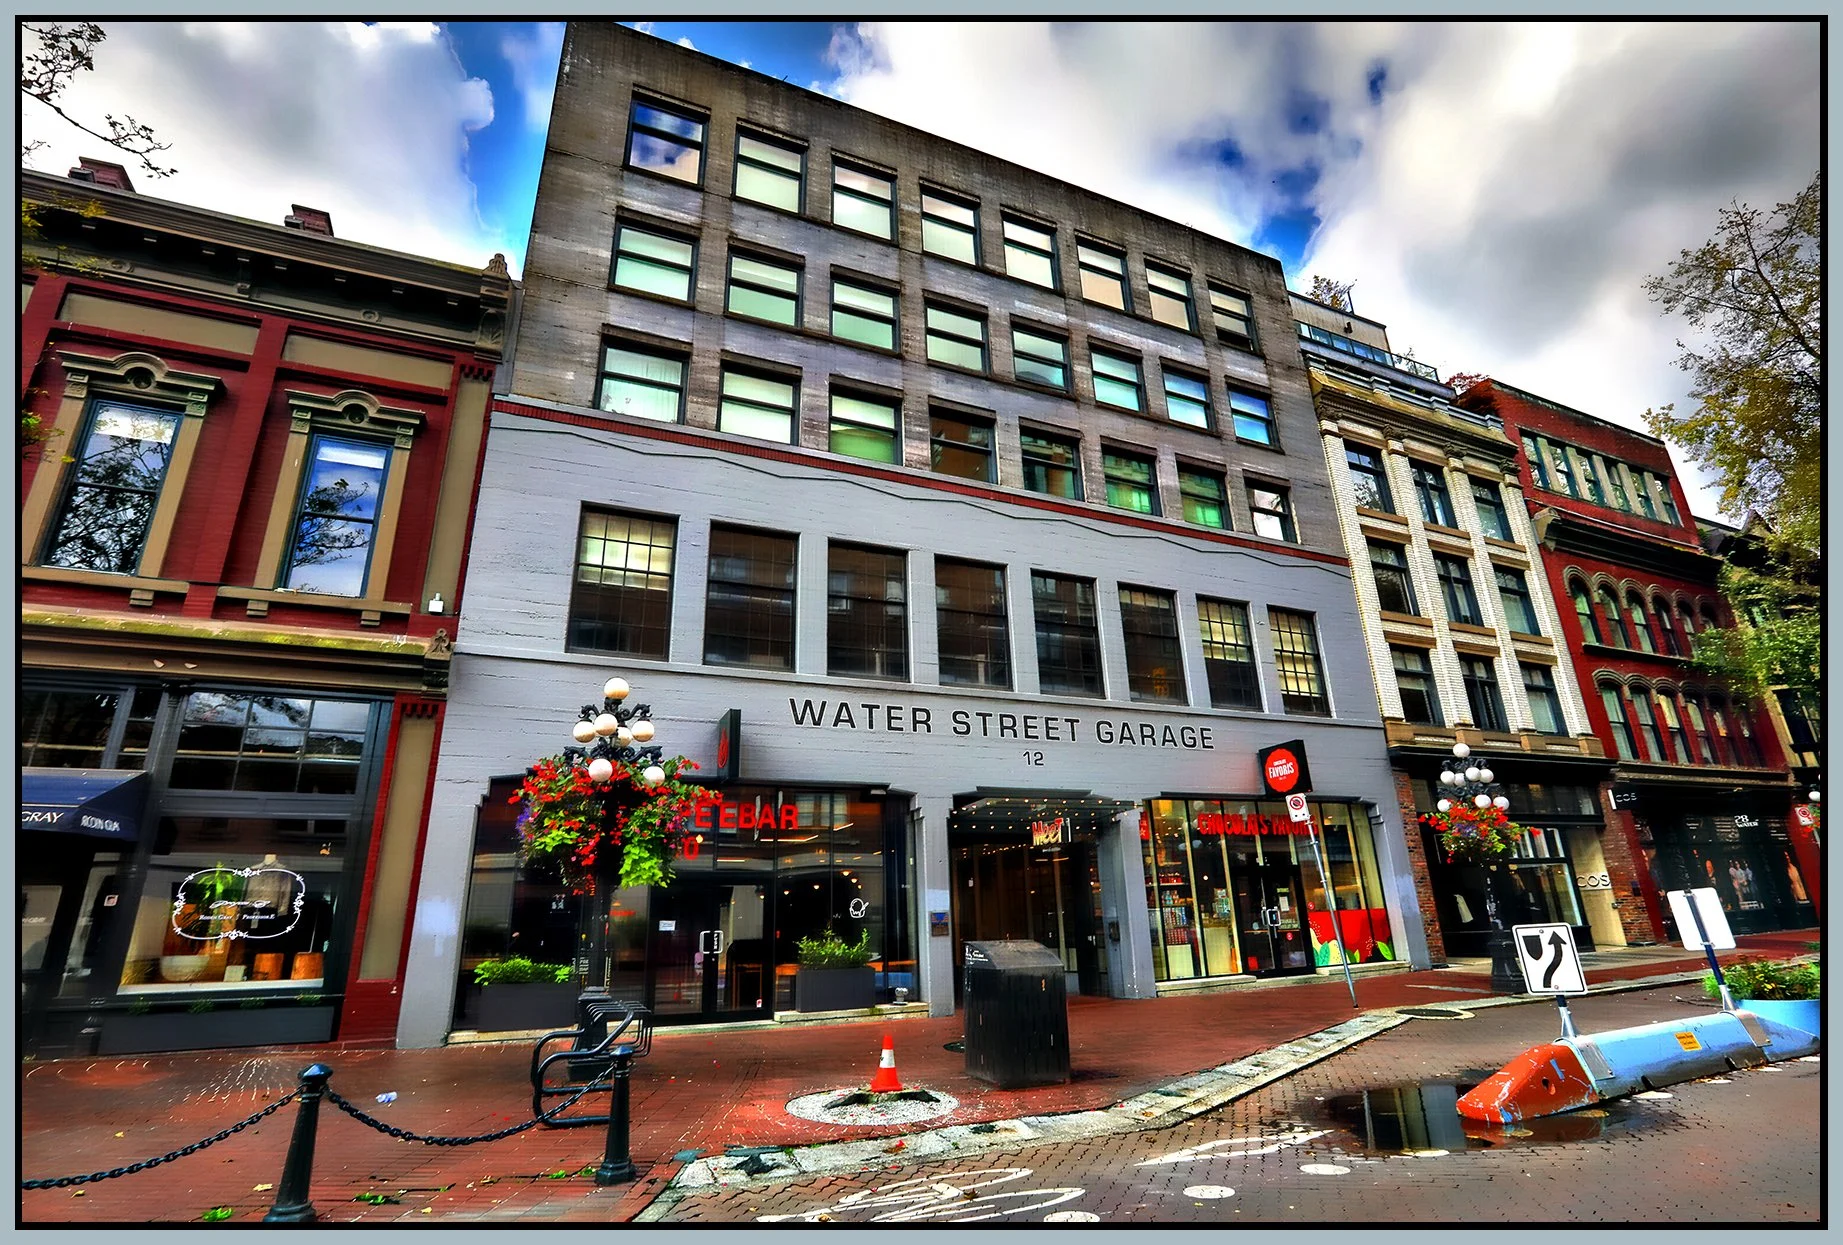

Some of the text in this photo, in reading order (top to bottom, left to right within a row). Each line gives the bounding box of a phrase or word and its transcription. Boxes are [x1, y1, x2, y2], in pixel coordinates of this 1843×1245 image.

[789, 698, 1215, 750] WATER STREET GARAGE
[1023, 750, 1044, 766] 12
[1268, 762, 1295, 779] FAVORIS
[1615, 792, 1637, 803] COS
[22, 811, 64, 823] GRAY
[1734, 814, 1749, 824] 28
[1576, 874, 1611, 888] COS
